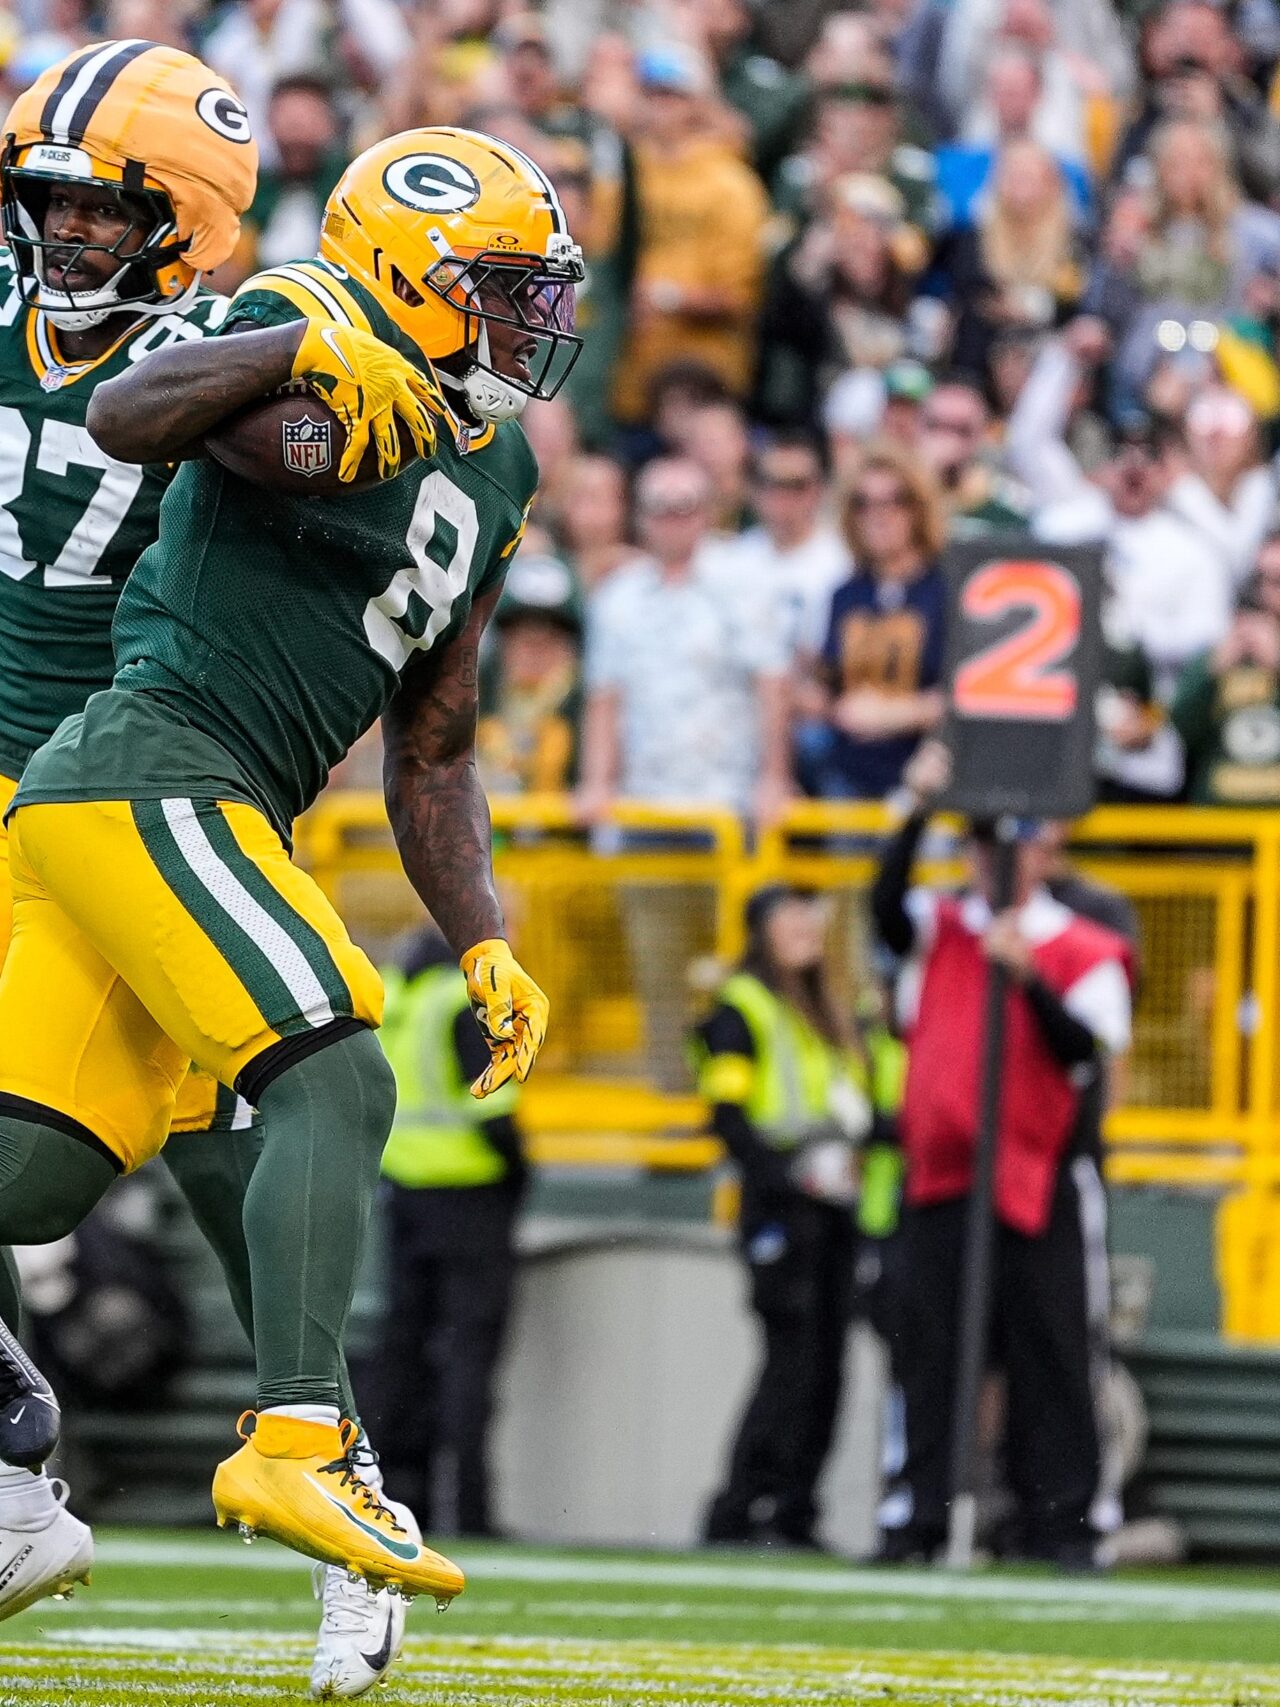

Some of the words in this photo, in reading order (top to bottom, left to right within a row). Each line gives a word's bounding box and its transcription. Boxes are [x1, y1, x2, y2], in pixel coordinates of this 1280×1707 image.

[383, 153, 481, 214] G
[489, 243, 524, 252] OAKLEY
[288, 444, 326, 470] NFL
[362, 469, 479, 672] 8
[953, 560, 1081, 720] 2
[13, 1544, 34, 1572] ZOOM
